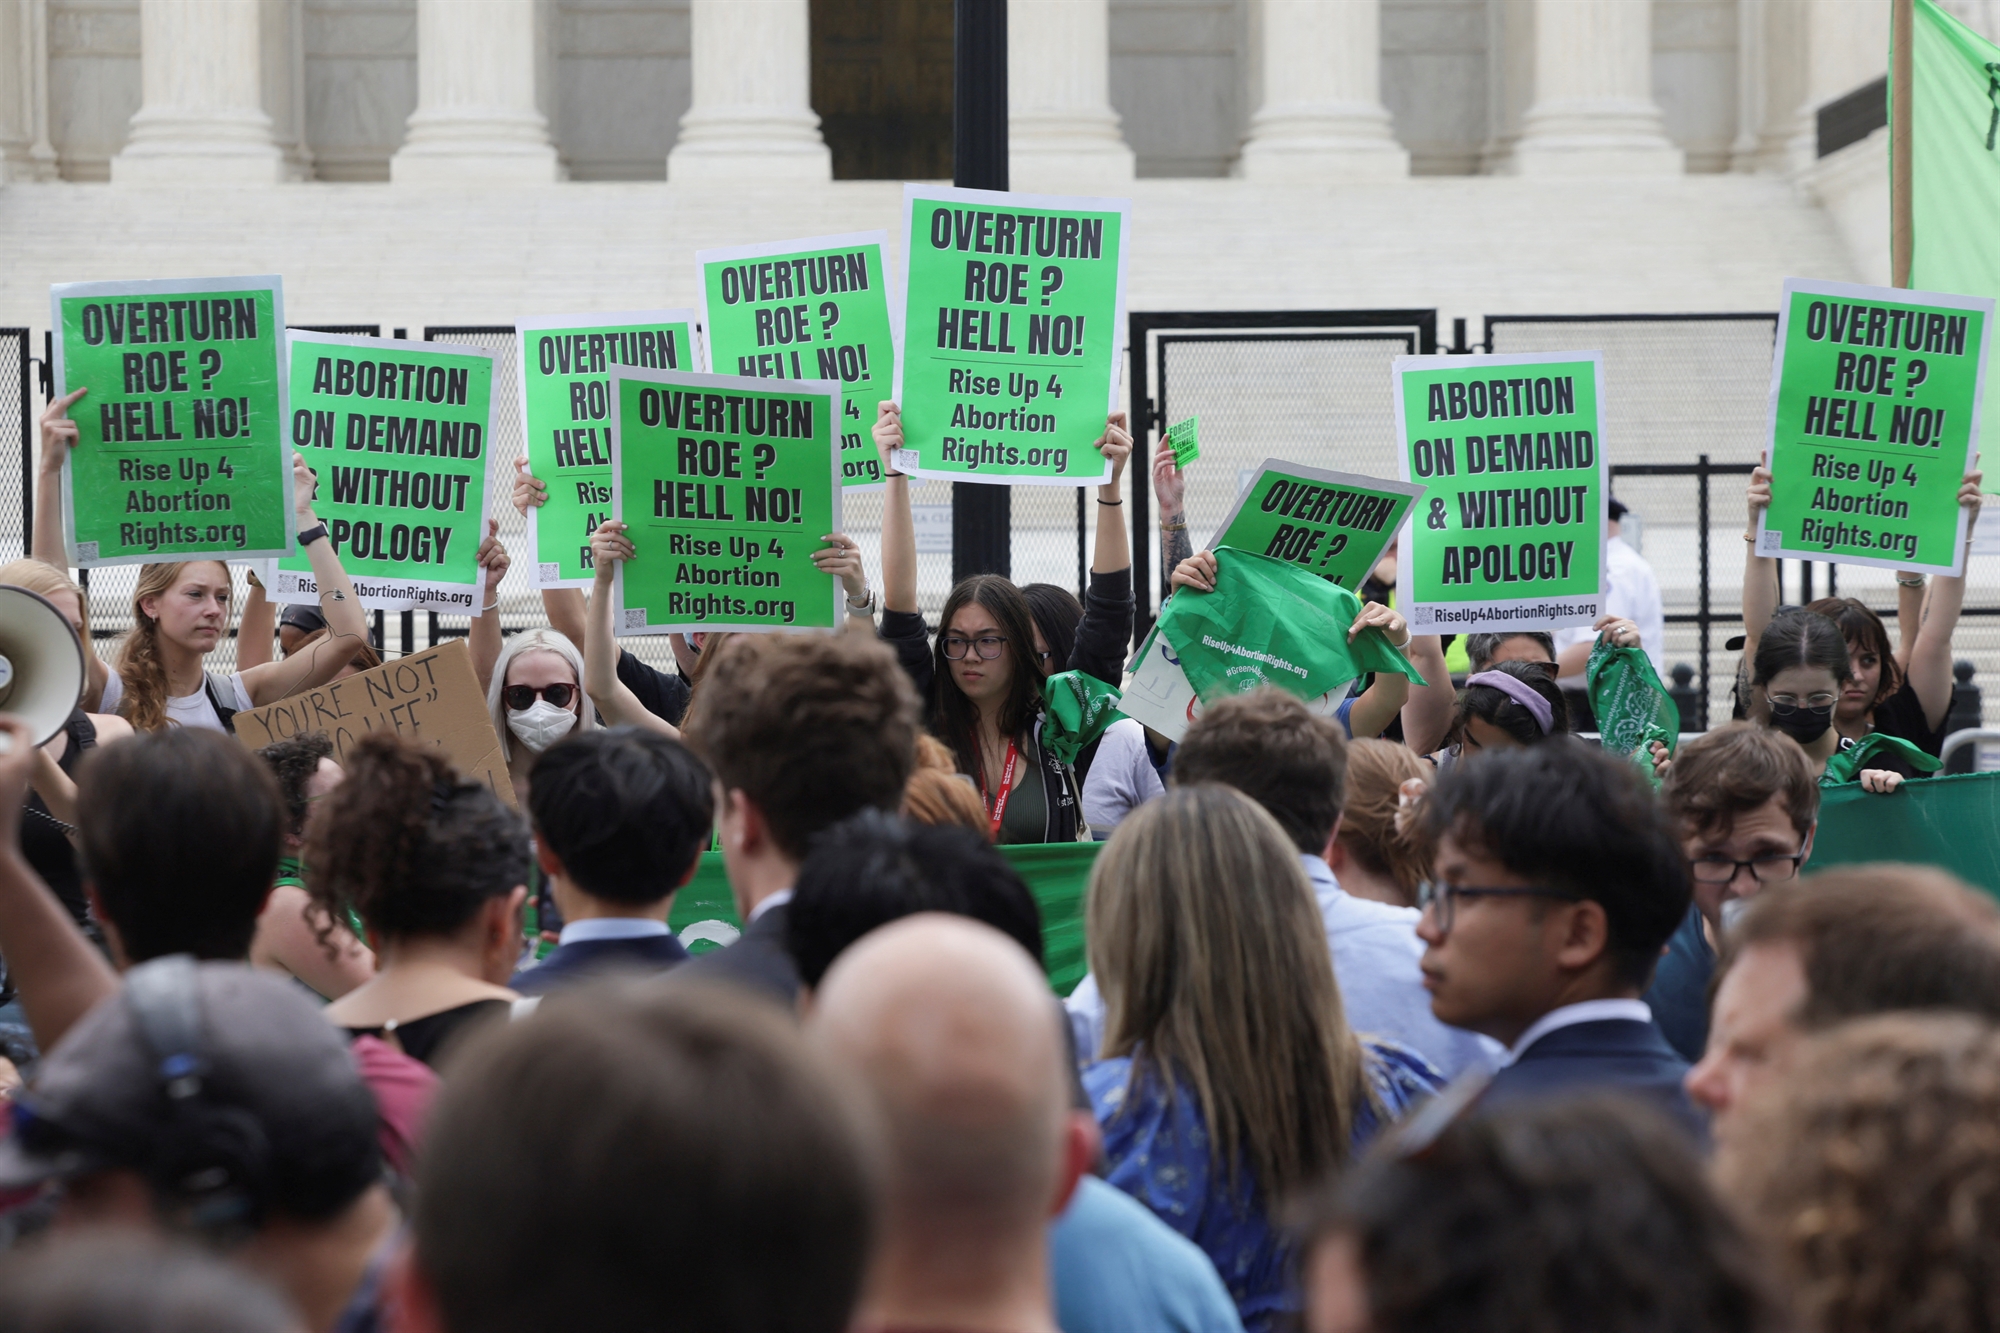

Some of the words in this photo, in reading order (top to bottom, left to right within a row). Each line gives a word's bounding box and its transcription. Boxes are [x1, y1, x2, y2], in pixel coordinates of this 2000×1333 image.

[931, 208, 1102, 258] OVERTURN
[722, 253, 869, 304] OVERTURN
[965, 260, 1028, 304] ROE
[1041, 266, 1062, 306] ?
[83, 298, 256, 345] OVERTURN
[755, 305, 811, 346] ROE
[820, 302, 839, 339] ?
[938, 307, 1015, 353] HELL
[1028, 314, 1084, 355] NO!
[1807, 302, 1968, 355] OVERTURN
[123, 351, 187, 393] ROE
[200, 349, 221, 390] ?
[539, 330, 677, 375] OVERTURN
[817, 344, 871, 382] NO!
[313, 358, 467, 405] ABORTION
[949, 369, 1000, 395] Rise
[1009, 373, 1038, 403] Up
[1046, 375, 1062, 398] 4
[1835, 352, 1896, 395] ROE
[1906, 360, 1927, 397] ?
[101, 401, 181, 442] HELL
[193, 397, 249, 438] NO!
[570, 382, 610, 420] RO
[640, 388, 812, 438] OVERTURN
[845, 399, 859, 419] 4
[951, 404, 1055, 432] Abortion
[1429, 377, 1573, 421] ABORTION
[293, 409, 334, 448] ON
[346, 414, 481, 459] DEMAND
[1170, 418, 1194, 438] FORCED
[1177, 435, 1194, 450] FEMALE
[1805, 396, 1877, 441] HELL
[1889, 405, 1944, 447] NO!
[119, 458, 170, 480] Rise
[179, 458, 209, 485] Up
[218, 456, 233, 478] 4
[678, 438, 741, 478] ROE
[754, 444, 775, 479] ?
[942, 437, 1067, 473] Rights.org
[1414, 438, 1455, 477] ON
[1466, 431, 1593, 473] DEMAND
[1812, 454, 1860, 480] Rise
[1868, 460, 1895, 489] Up
[1903, 464, 1917, 486] 4
[126, 488, 230, 512] Abortion
[332, 466, 470, 511] WITHOUT
[576, 481, 613, 503] Ris
[654, 480, 733, 520] HELL
[746, 487, 801, 523] NO!
[1261, 480, 1397, 532] OVERTURN
[1427, 498, 1447, 529] &
[1458, 486, 1587, 528] WITHOUT
[1811, 487, 1908, 518] Abortion
[121, 522, 245, 550] Rights.org
[317, 518, 451, 564] POLOGY
[670, 534, 721, 556] Rise
[730, 537, 759, 562] Up
[768, 539, 783, 558] 4
[1264, 524, 1326, 564] ROE
[1320, 534, 1347, 567] ?
[1801, 518, 1917, 558] Rights.org
[676, 563, 779, 586] Abortion
[1442, 541, 1573, 584] APOLOGY
[298, 578, 473, 606] RisAbortionRights.org
[669, 592, 794, 622] Rights.org
[1435, 604, 1596, 624] RiseUp4AbortionRights.org
[1202, 635, 1308, 679] RiseUp4AbortionRights.org
[253, 684, 352, 743] YOU'RE
[365, 655, 438, 706] NOT
